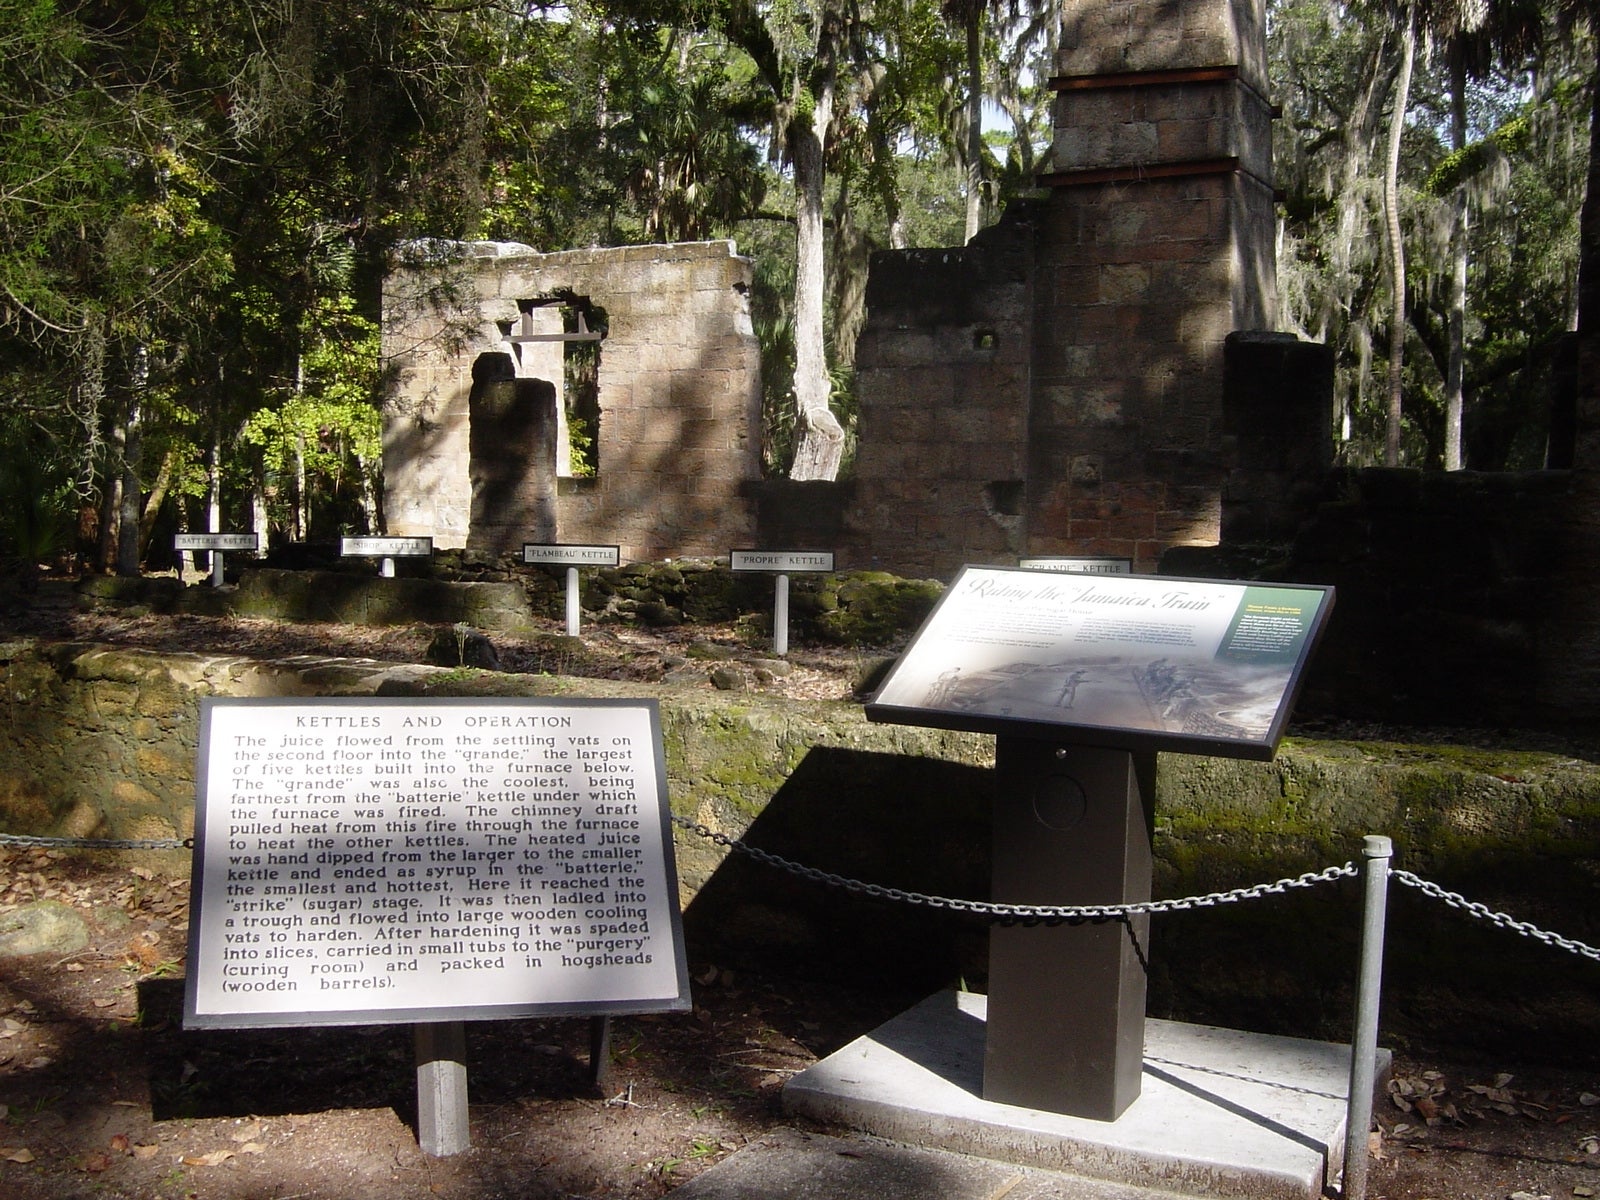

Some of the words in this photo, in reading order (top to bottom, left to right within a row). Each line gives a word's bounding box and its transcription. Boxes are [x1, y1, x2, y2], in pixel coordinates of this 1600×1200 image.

[223, 537, 253, 545] KETTLE
[389, 542, 421, 550] KETTLE
[529, 549, 578, 558] "FLAMBEAU"
[581, 551, 614, 559] KETTLE
[740, 556, 783, 565] "PROPRE"
[788, 557, 825, 565] KETTLE
[1082, 564, 1121, 574] KETTLE
[967, 579, 1032, 601] Riding
[1034, 586, 1060, 600] the
[297, 716, 380, 728] KETTLES
[402, 716, 442, 727] AND
[464, 716, 571, 728] OPERATION
[234, 736, 266, 746] The
[280, 734, 324, 748] juice
[337, 735, 392, 746] flowed
[406, 735, 444, 746] from
[456, 735, 481, 745] the
[493, 734, 555, 748] settling
[568, 736, 600, 745] vats
[612, 737, 631, 746] on
[235, 750, 260, 760] the
[267, 750, 324, 760] second
[333, 750, 373, 760] floor
[381, 749, 411, 760] into
[421, 749, 446, 760] the
[543, 749, 568, 759] the
[576, 749, 632, 762] largest
[232, 764, 250, 775] of
[262, 764, 293, 775] five
[306, 764, 363, 774] kettles
[375, 763, 412, 774] built
[424, 762, 456, 774] into
[469, 763, 494, 773] the
[508, 762, 572, 773] furnace
[584, 762, 634, 773] below.
[232, 778, 264, 790] The
[277, 778, 352, 792] "grande"
[370, 780, 400, 789] was
[413, 778, 447, 788] also
[462, 776, 488, 788] the
[588, 775, 634, 790] being
[232, 794, 297, 804] farthest
[307, 793, 345, 804] from
[356, 792, 381, 803] the
[477, 790, 526, 802] kettle
[533, 790, 580, 802] under
[588, 789, 636, 801] which
[231, 808, 257, 819] the
[272, 808, 340, 819] furnace
[354, 809, 384, 818] was
[398, 806, 446, 818] fired.
[465, 805, 498, 817] The
[511, 804, 582, 818] chimney
[595, 804, 638, 815] draft
[230, 823, 282, 837] pulled
[291, 822, 327, 834] heat
[336, 822, 376, 833] from
[386, 820, 416, 832] this
[425, 820, 456, 832] fire
[466, 819, 532, 834] through
[541, 819, 568, 830] the
[576, 818, 639, 830] furnace
[229, 839, 246, 850] to
[258, 838, 295, 850] heat
[307, 838, 334, 849] the
[346, 836, 393, 848] other
[405, 835, 469, 848] kettles.
[484, 834, 517, 846] The
[528, 833, 586, 845] heated
[598, 832, 640, 846] juice
[229, 856, 261, 865] was
[268, 852, 308, 864] hand
[316, 851, 374, 866] dipped
[382, 851, 421, 863] from
[430, 850, 455, 861] the
[462, 849, 515, 864] larger
[523, 849, 540, 860] to
[547, 848, 574, 860] the
[582, 847, 642, 859] smaller
[228, 868, 279, 881] kettle
[290, 867, 321, 880] and
[334, 866, 386, 879] ended
[397, 868, 415, 878] as
[426, 866, 476, 879] syrup
[489, 863, 503, 875] in
[516, 864, 544, 875] the
[227, 884, 254, 896] the
[264, 882, 336, 895] smallest
[345, 881, 377, 894] and
[468, 878, 510, 891] Here
[520, 878, 532, 890] it
[541, 876, 610, 890] reached
[618, 876, 644, 888] the
[226, 897, 293, 912] "strike"
[302, 896, 362, 913] (sugar)
[372, 897, 423, 911] stage.
[440, 894, 451, 907] It
[462, 896, 493, 906] was
[504, 894, 542, 905] then
[553, 891, 605, 904] ladled
[614, 890, 646, 903] into
[225, 918, 234, 927] a
[243, 914, 303, 930] trough
[310, 913, 340, 926] and
[349, 911, 408, 925] flowed
[416, 910, 450, 923] into
[458, 910, 504, 924] large
[511, 908, 576, 920] wooden
[585, 905, 647, 921] cooling
[225, 932, 260, 943] vats
[269, 931, 287, 942] to
[296, 929, 362, 942] harden.
[374, 927, 422, 940] After
[430, 924, 520, 939] hardening
[529, 923, 541, 936] it
[550, 925, 581, 935] was
[590, 921, 649, 936] spaded
[224, 947, 258, 960] into
[265, 946, 318, 959] slices,
[326, 944, 392, 957] carried
[398, 942, 413, 955] in
[419, 941, 464, 955] small
[469, 940, 506, 953] tubs
[512, 941, 529, 952] to
[534, 940, 562, 951] the
[567, 936, 650, 953] "purgery"
[223, 963, 288, 979] (curing
[311, 960, 364, 974] room)
[386, 959, 418, 972] and
[441, 956, 504, 973] packed
[526, 954, 542, 968] in
[562, 952, 652, 969] hogsheads
[222, 979, 297, 992] (wooden
[320, 976, 395, 990] barrels).
